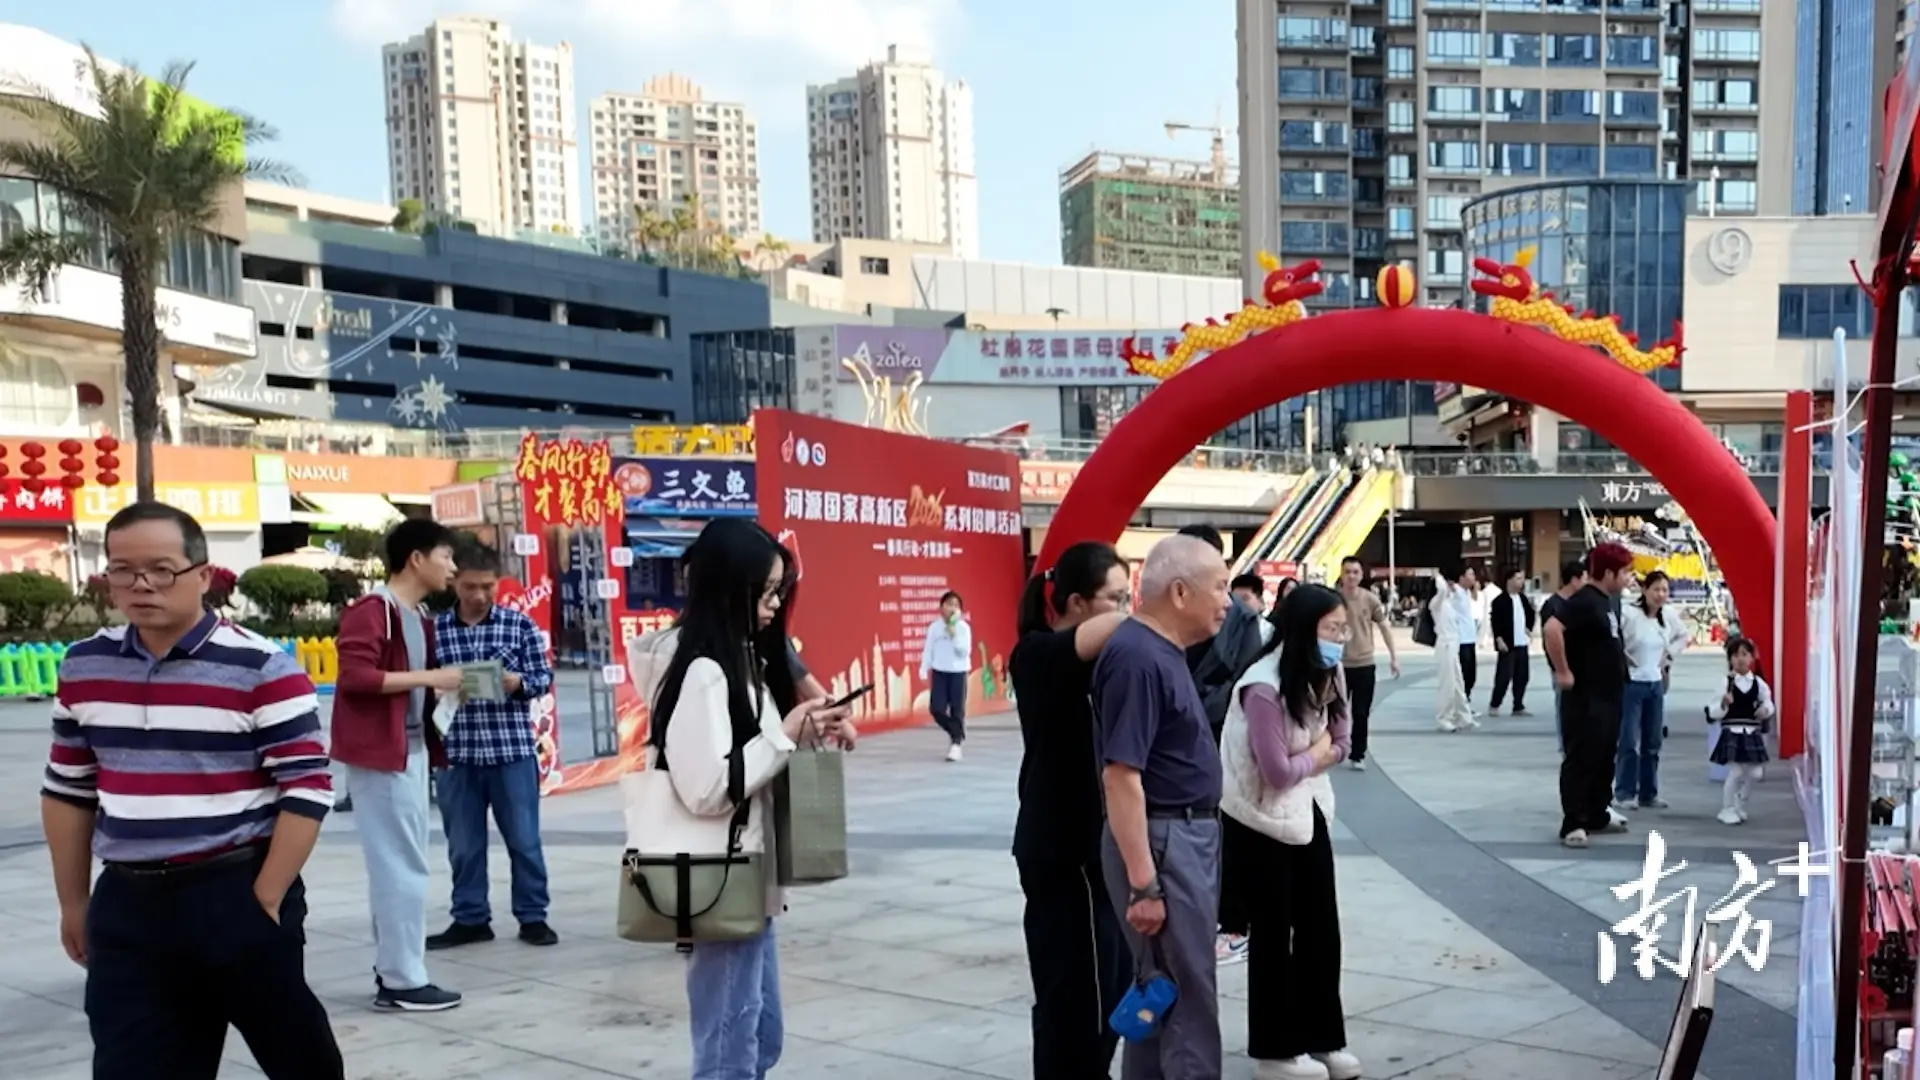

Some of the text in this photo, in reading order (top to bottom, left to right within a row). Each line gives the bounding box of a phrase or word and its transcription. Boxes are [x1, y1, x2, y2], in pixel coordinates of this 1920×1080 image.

[854, 342, 922, 368] Azalea
[287, 464, 349, 484] NAIXUE
[518, 435, 611, 488] 春风行动
[533, 475, 624, 524] 才聚高新
